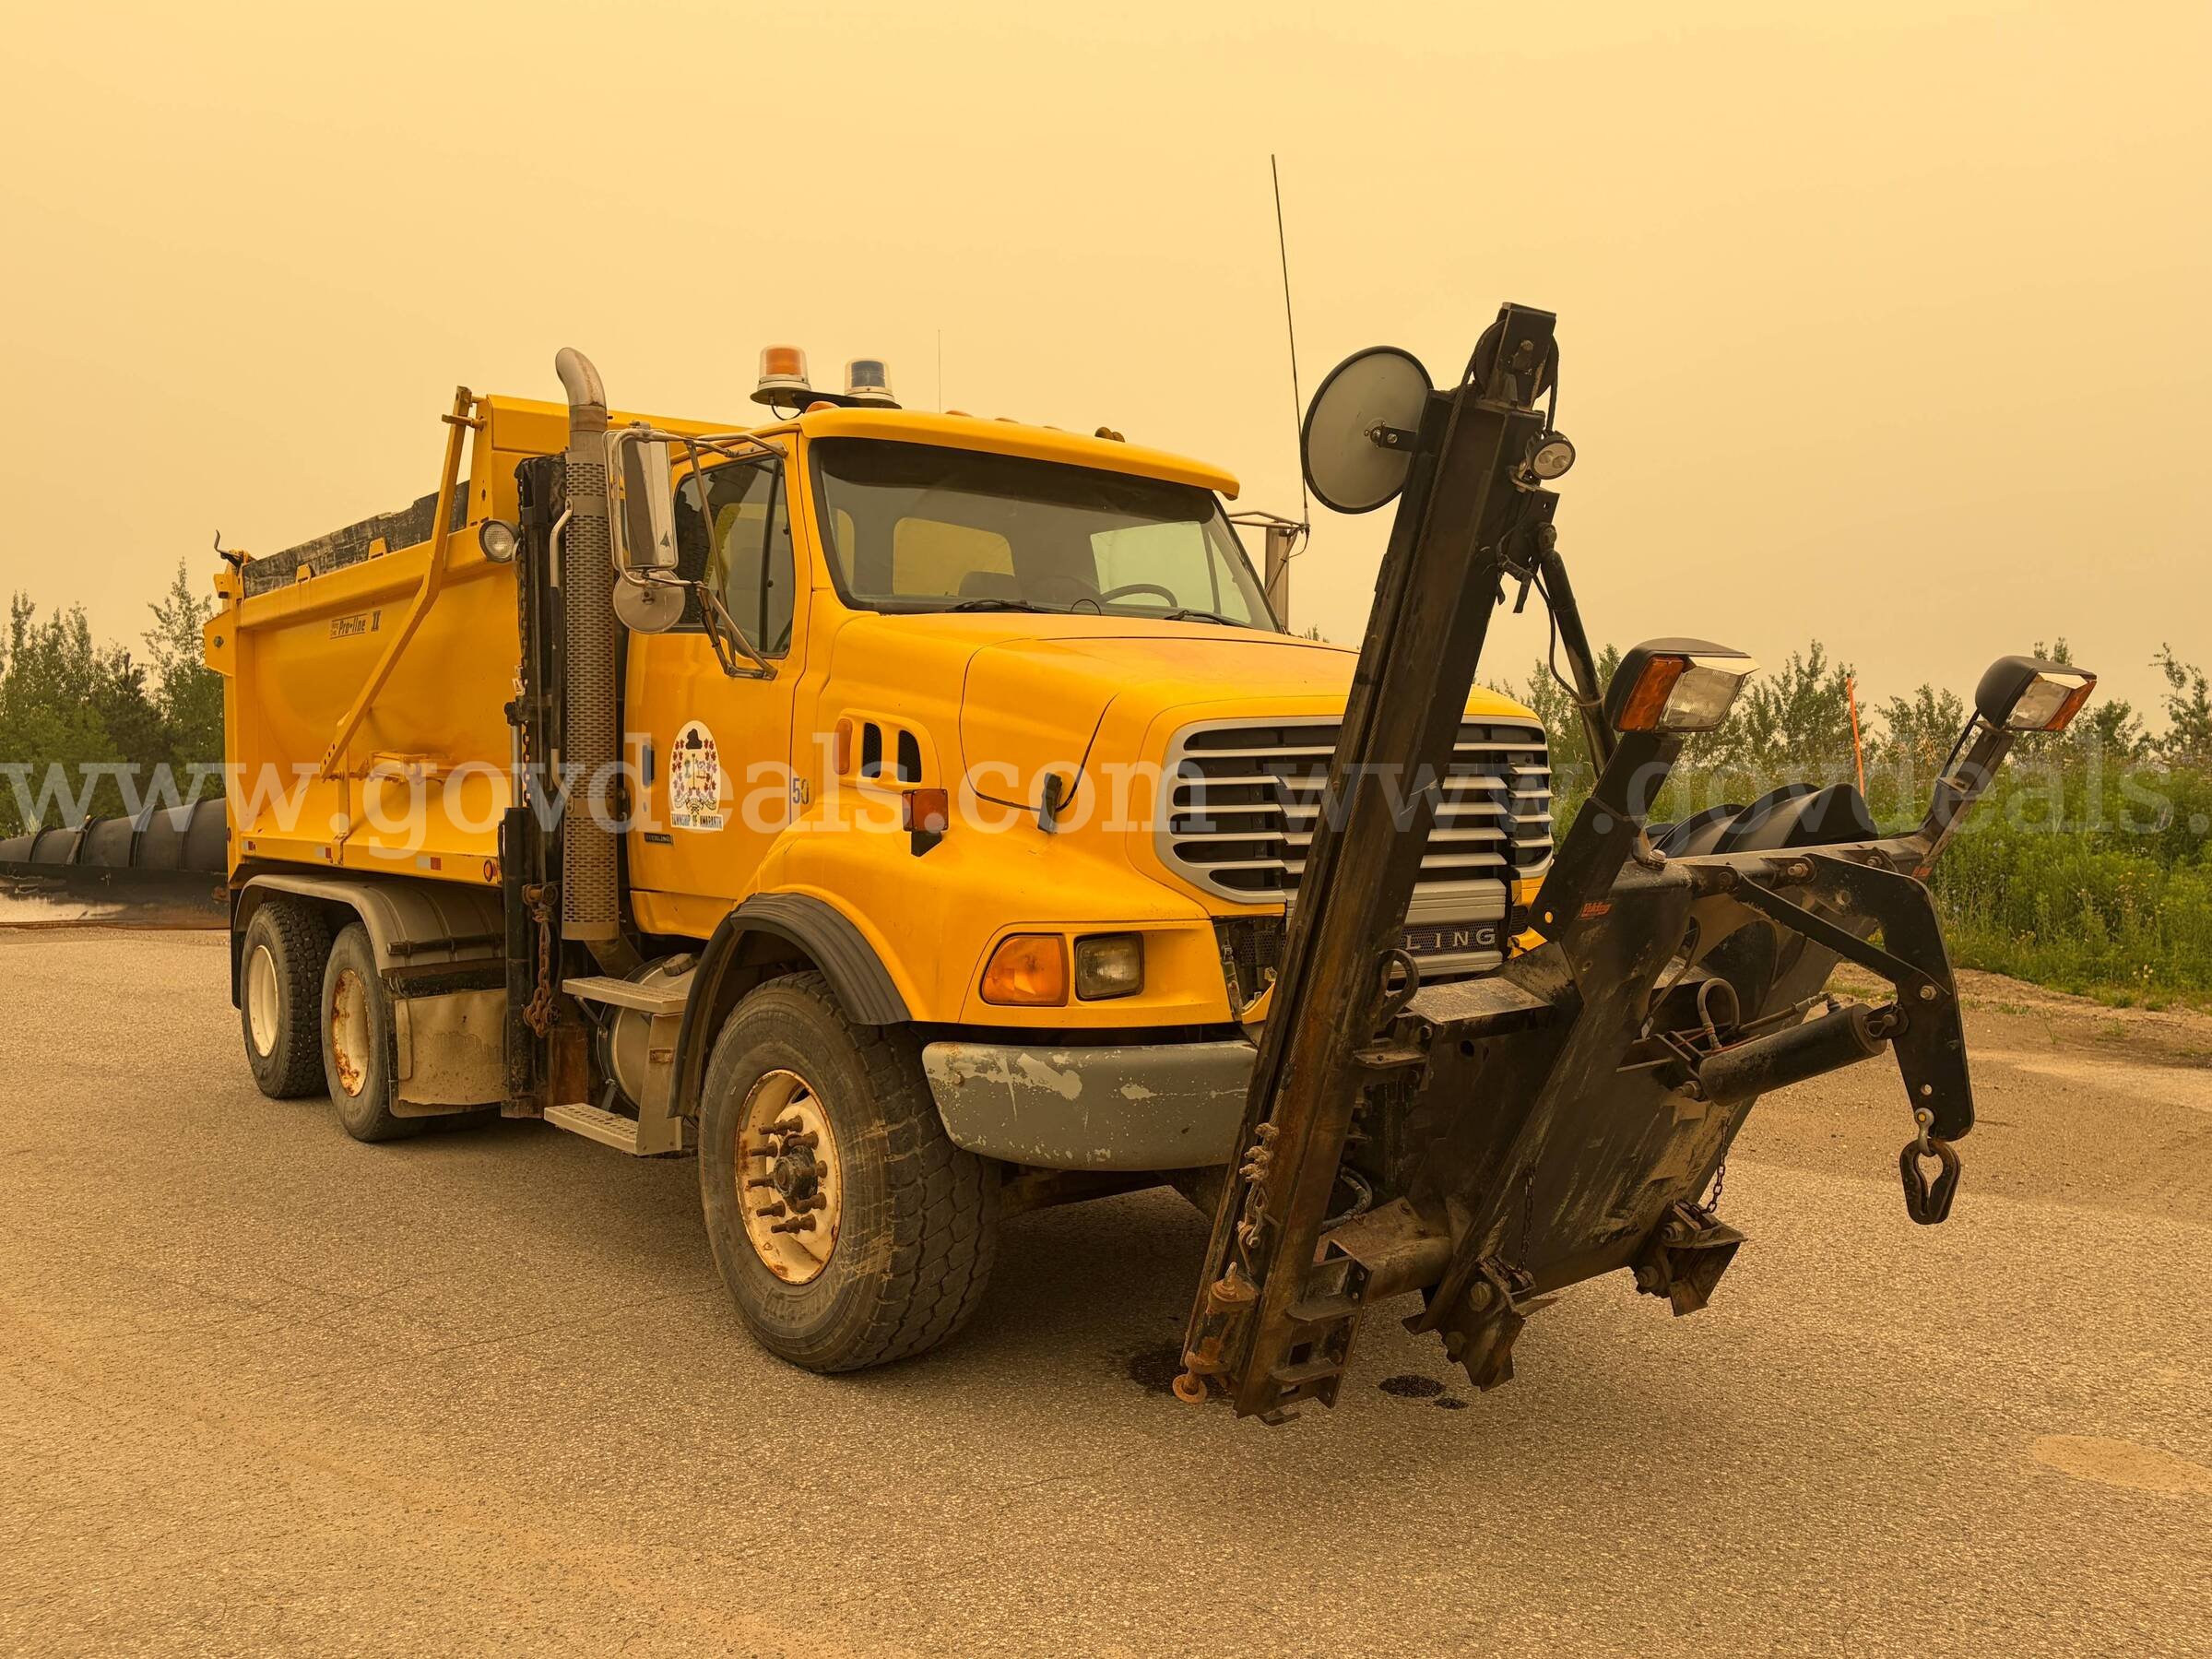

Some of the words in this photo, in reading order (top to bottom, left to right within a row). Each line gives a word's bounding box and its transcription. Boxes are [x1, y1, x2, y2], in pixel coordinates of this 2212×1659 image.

[671, 813, 691, 826] TOWNSHIP
[692, 814, 698, 827] OF
[1405, 928, 1496, 950] LING
